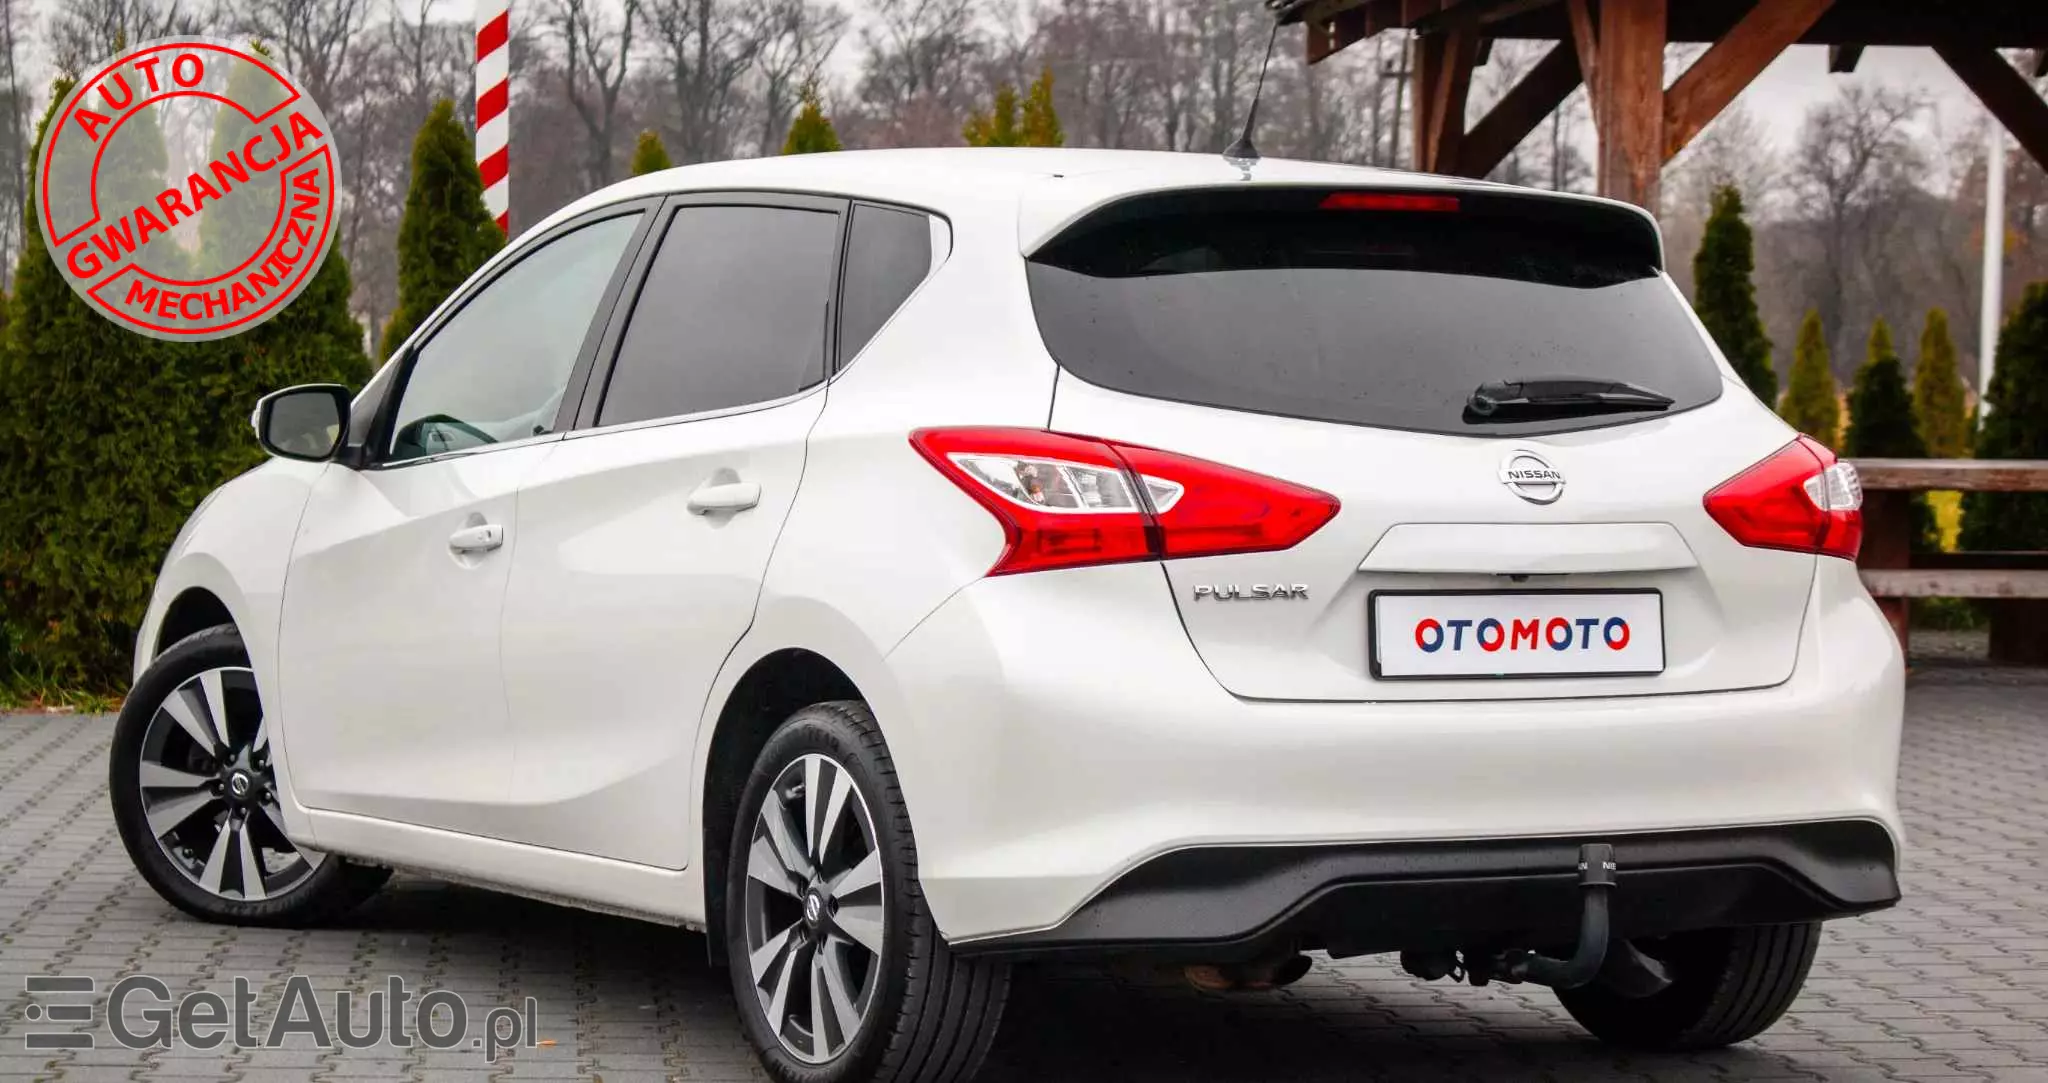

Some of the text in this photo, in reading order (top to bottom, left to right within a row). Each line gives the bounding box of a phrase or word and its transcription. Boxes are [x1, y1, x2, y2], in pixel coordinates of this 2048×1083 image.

[1507, 470, 1561, 479] NISSAN
[1193, 583, 1309, 602] PULSAR
[1415, 616, 1630, 653] OTOMOTO
